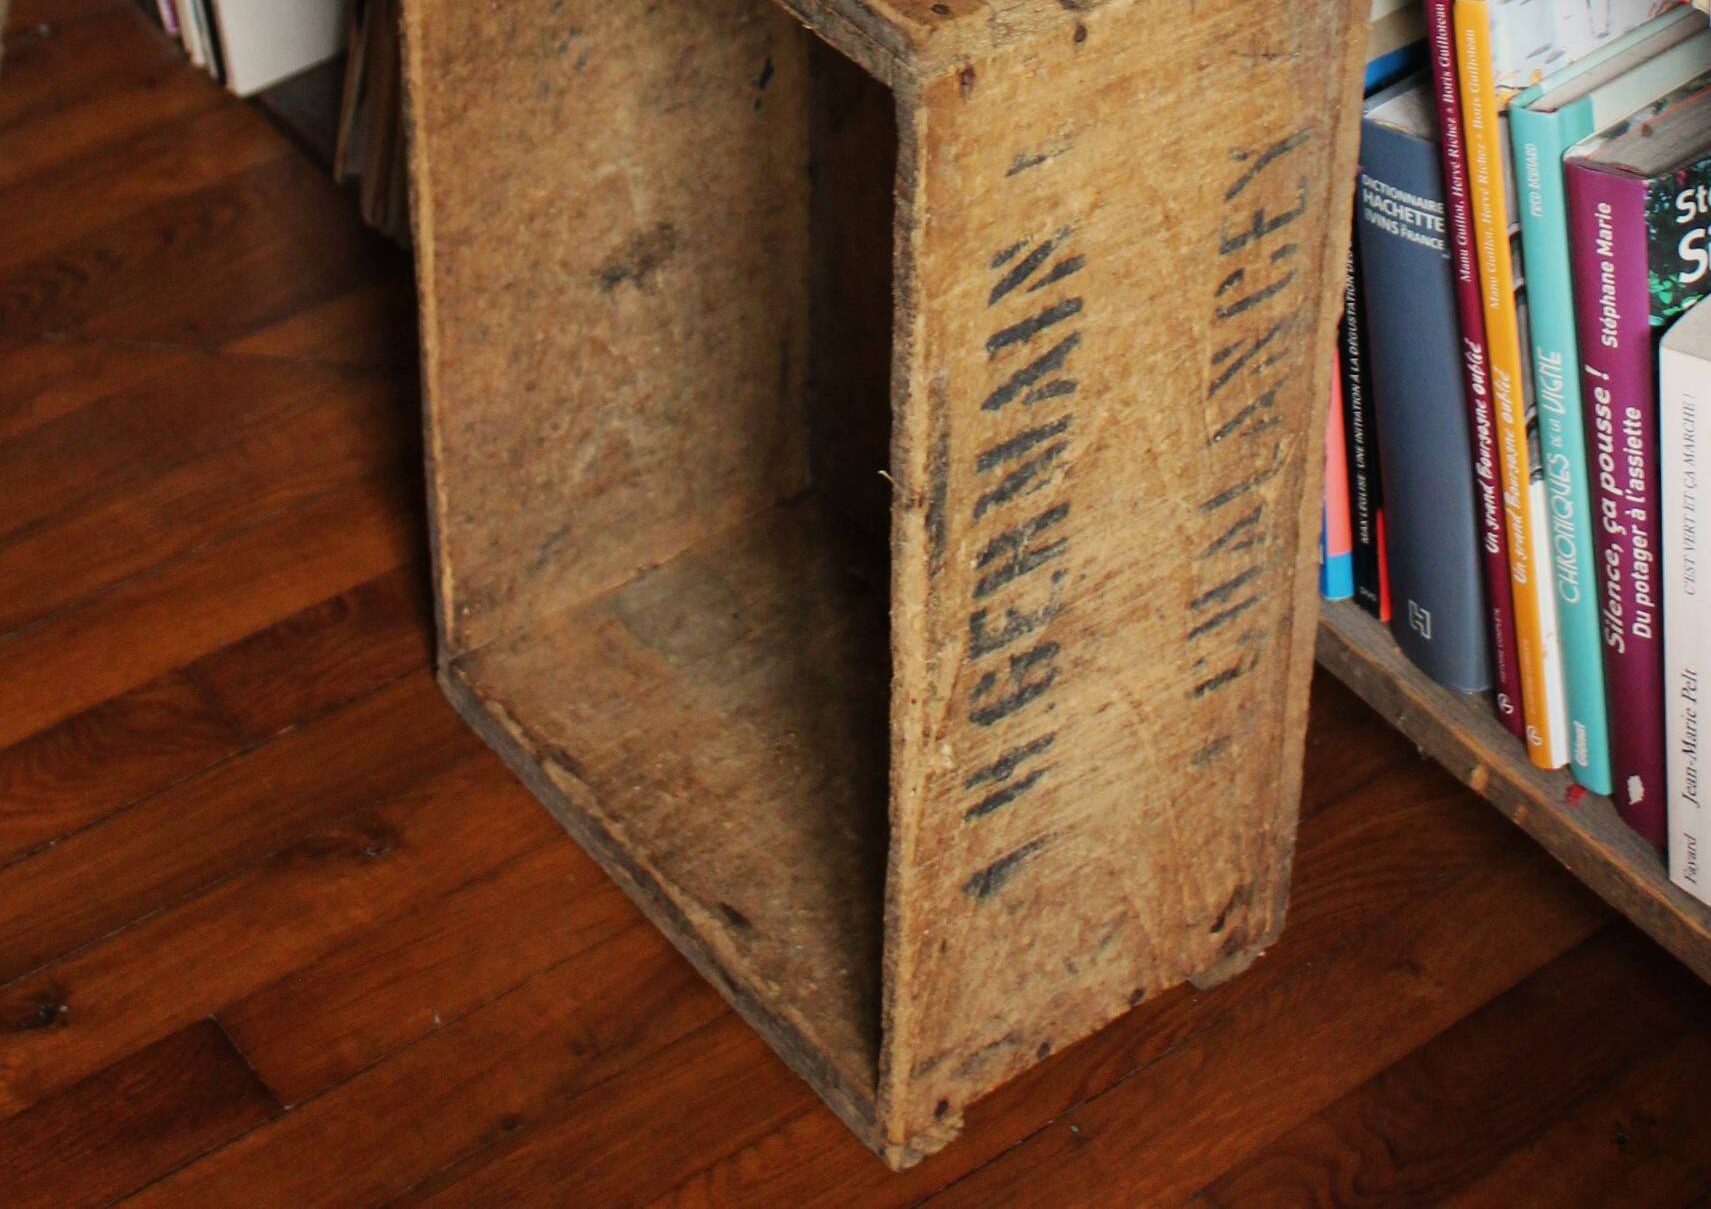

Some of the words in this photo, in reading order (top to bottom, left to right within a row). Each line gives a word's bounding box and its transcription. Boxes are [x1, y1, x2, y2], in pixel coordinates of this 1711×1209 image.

[1436, 4, 1452, 67] Guilloteau
[1464, 30, 1481, 93] Guilloteau
[1442, 71, 1455, 103] Boris
[1470, 97, 1484, 127] Boris
[1446, 117, 1460, 158] Richez
[1450, 161, 1464, 196] Hervé
[1474, 143, 1489, 183] Richez
[1362, 174, 1444, 214] DICTIONNAIRE
[1363, 189, 1445, 232] HACHETTE
[1478, 187, 1493, 224] Hervé
[1676, 185, 1711, 223] St
[1400, 227, 1445, 250] FRANCE
[1453, 201, 1468, 245] Guillot,
[1594, 203, 1614, 256] Marie
[1458, 250, 1471, 282] Manu
[1486, 277, 1500, 309] Manu
[1597, 261, 1619, 347] Stéphane
[1347, 277, 1361, 355] DÉGUSTATION
[1351, 358, 1362, 373] LA
[1465, 339, 1488, 393] oublié
[1538, 347, 1565, 415] VIGNE
[1585, 365, 1609, 380] !
[1352, 385, 1365, 445] INITIATION
[1494, 367, 1517, 424] oublié
[1471, 400, 1495, 477] Bourgogne
[1587, 387, 1616, 494] pousse
[1622, 407, 1645, 503] l'assiette
[1682, 403, 1695, 466] MARCHE
[967, 223, 1085, 728] GERMAIN
[1355, 448, 1366, 467] UNE
[1500, 430, 1524, 508] Bourgogne
[1682, 470, 1695, 489] ÇA
[1478, 482, 1499, 530] grand
[1595, 497, 1619, 535] ça
[1626, 510, 1646, 521] à
[1683, 494, 1695, 511] ET
[1359, 519, 1370, 543] MAX
[1483, 533, 1500, 553] Un
[1507, 512, 1527, 560] grand
[1545, 452, 1581, 603] CHRONIQUES
[1683, 515, 1696, 551] VERT
[1511, 563, 1529, 584] Un
[1627, 526, 1650, 607] potager
[1683, 557, 1696, 595] C'EST
[1598, 543, 1626, 653] Silence,
[1630, 611, 1652, 638] Du
[1681, 668, 1698, 703] Pelt
[1681, 707, 1700, 807] Jean-Marie
[1682, 834, 1698, 883] Fayard
